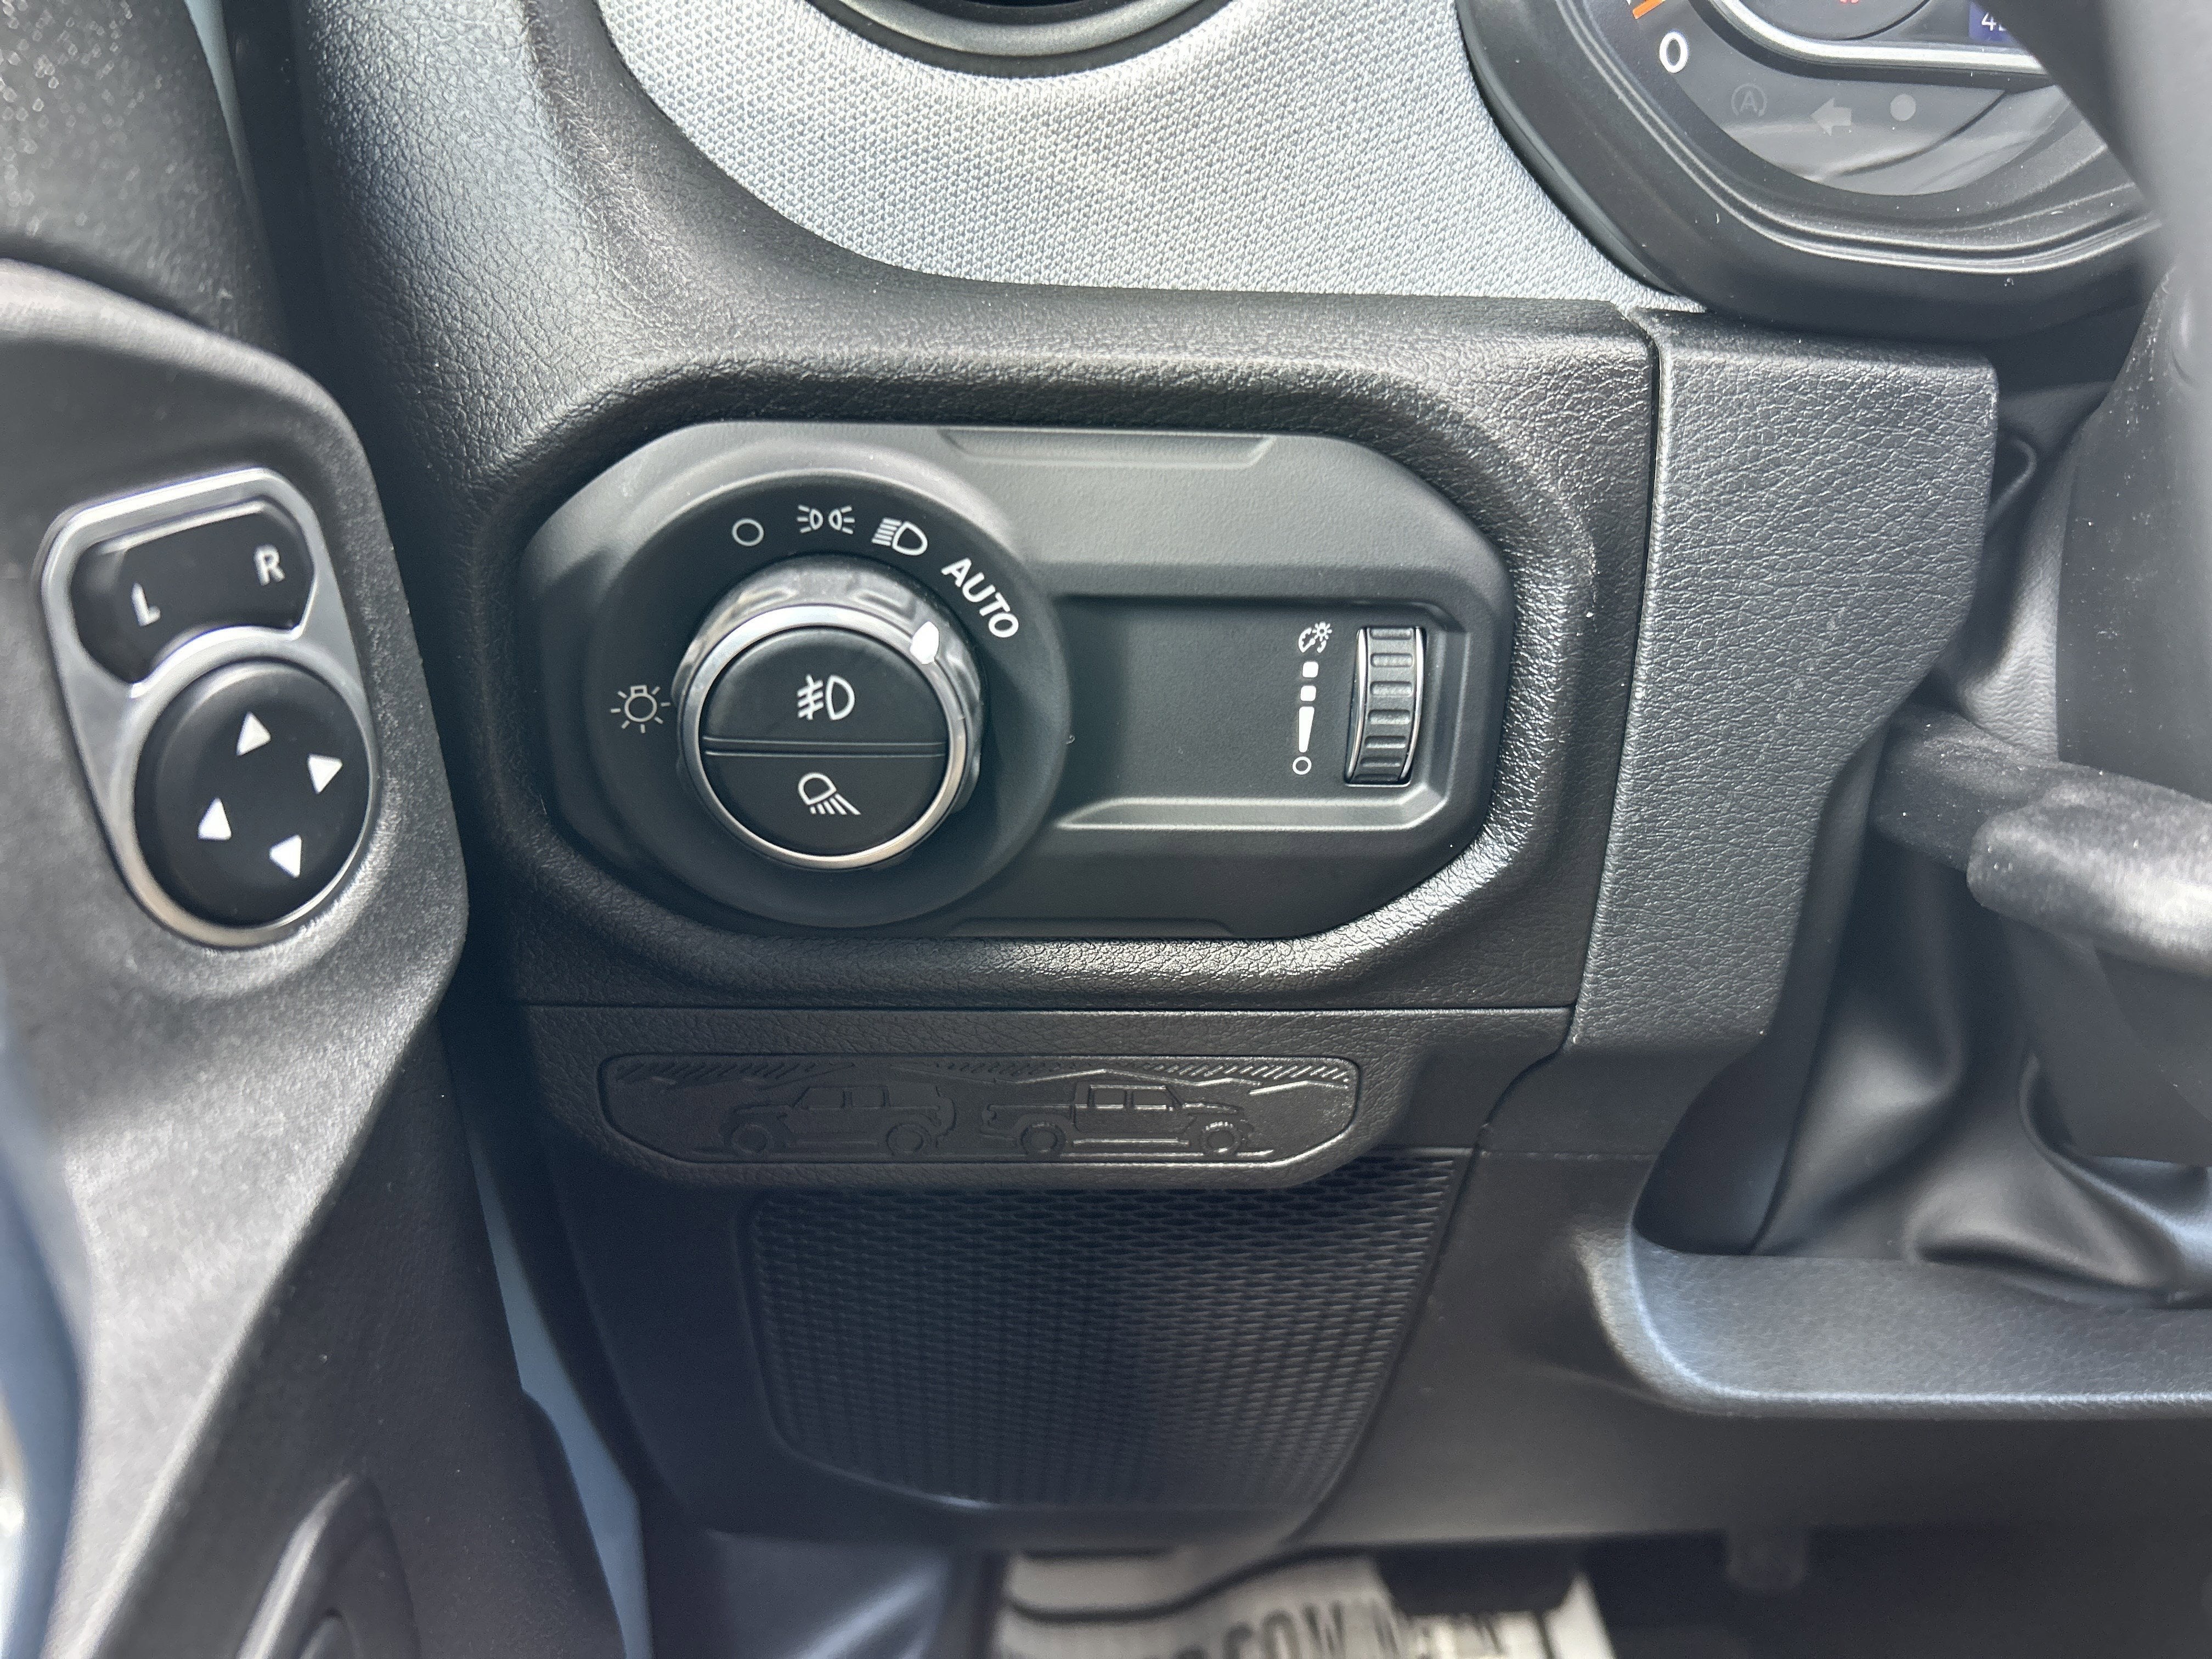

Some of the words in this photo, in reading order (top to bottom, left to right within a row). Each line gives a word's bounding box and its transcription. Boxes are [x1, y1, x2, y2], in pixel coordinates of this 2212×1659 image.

[1660, 31, 1688, 73] 0
[253, 544, 285, 585] R
[131, 582, 161, 627] L
[941, 557, 1019, 637] AUTO
